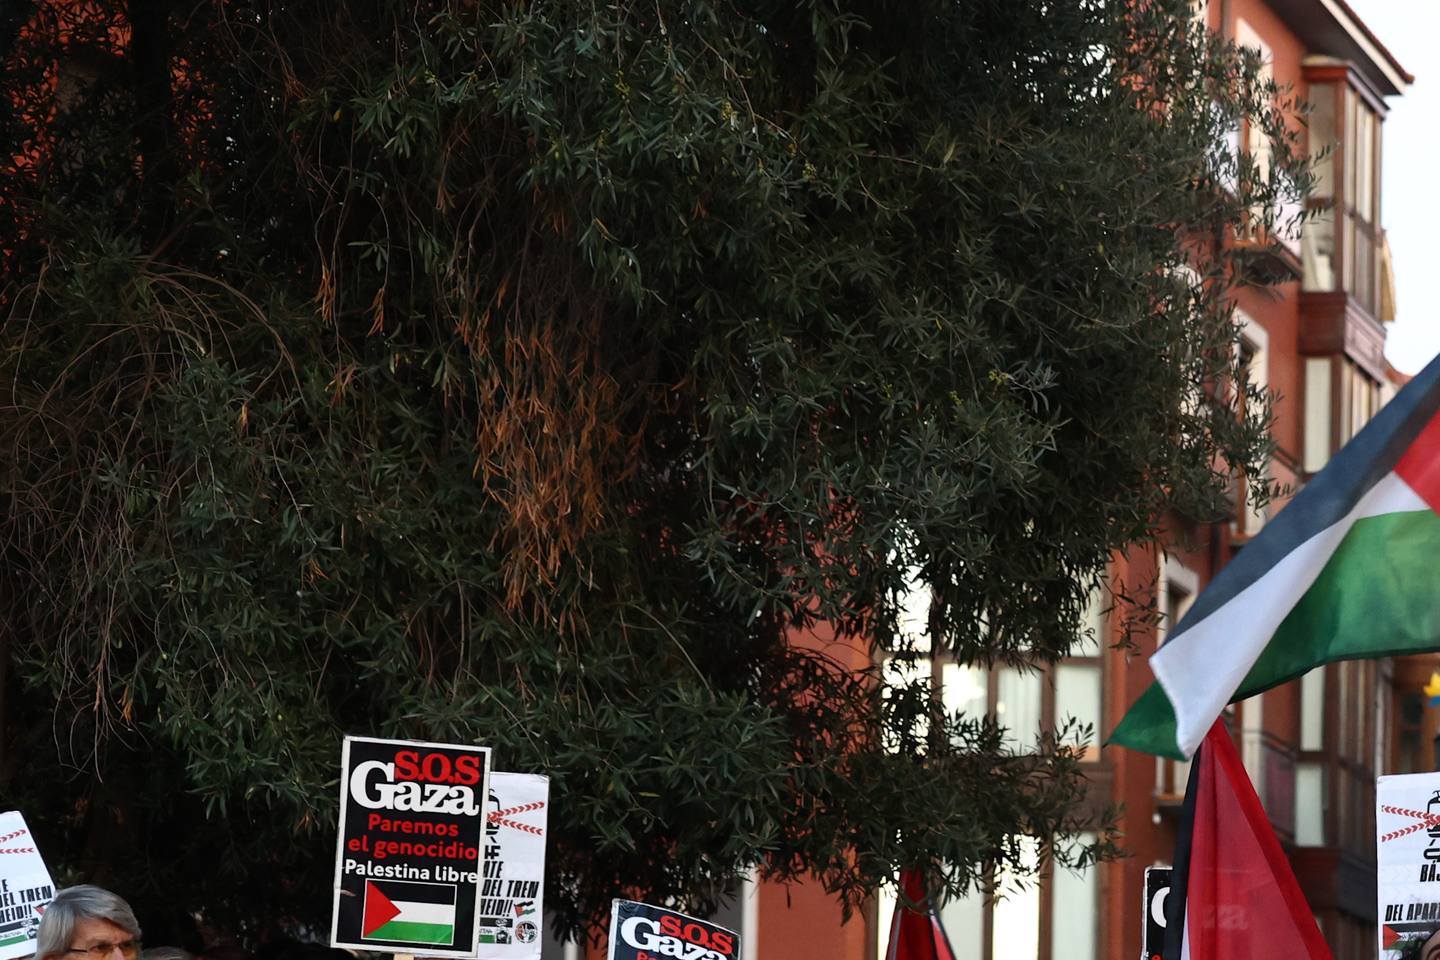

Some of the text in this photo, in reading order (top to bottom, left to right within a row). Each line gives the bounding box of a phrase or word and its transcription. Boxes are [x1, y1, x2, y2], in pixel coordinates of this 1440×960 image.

[394, 750, 480, 784] S.O.S
[350, 760, 480, 816] Gaza
[368, 813, 460, 836] Paremos
[348, 835, 478, 860] el genocidio
[345, 859, 478, 884] Palestina libre
[19, 885, 52, 903] TREN
[482, 879, 540, 898] DEL TREN
[1385, 904, 1403, 922] DEL
[660, 915, 732, 954] S.O.S
